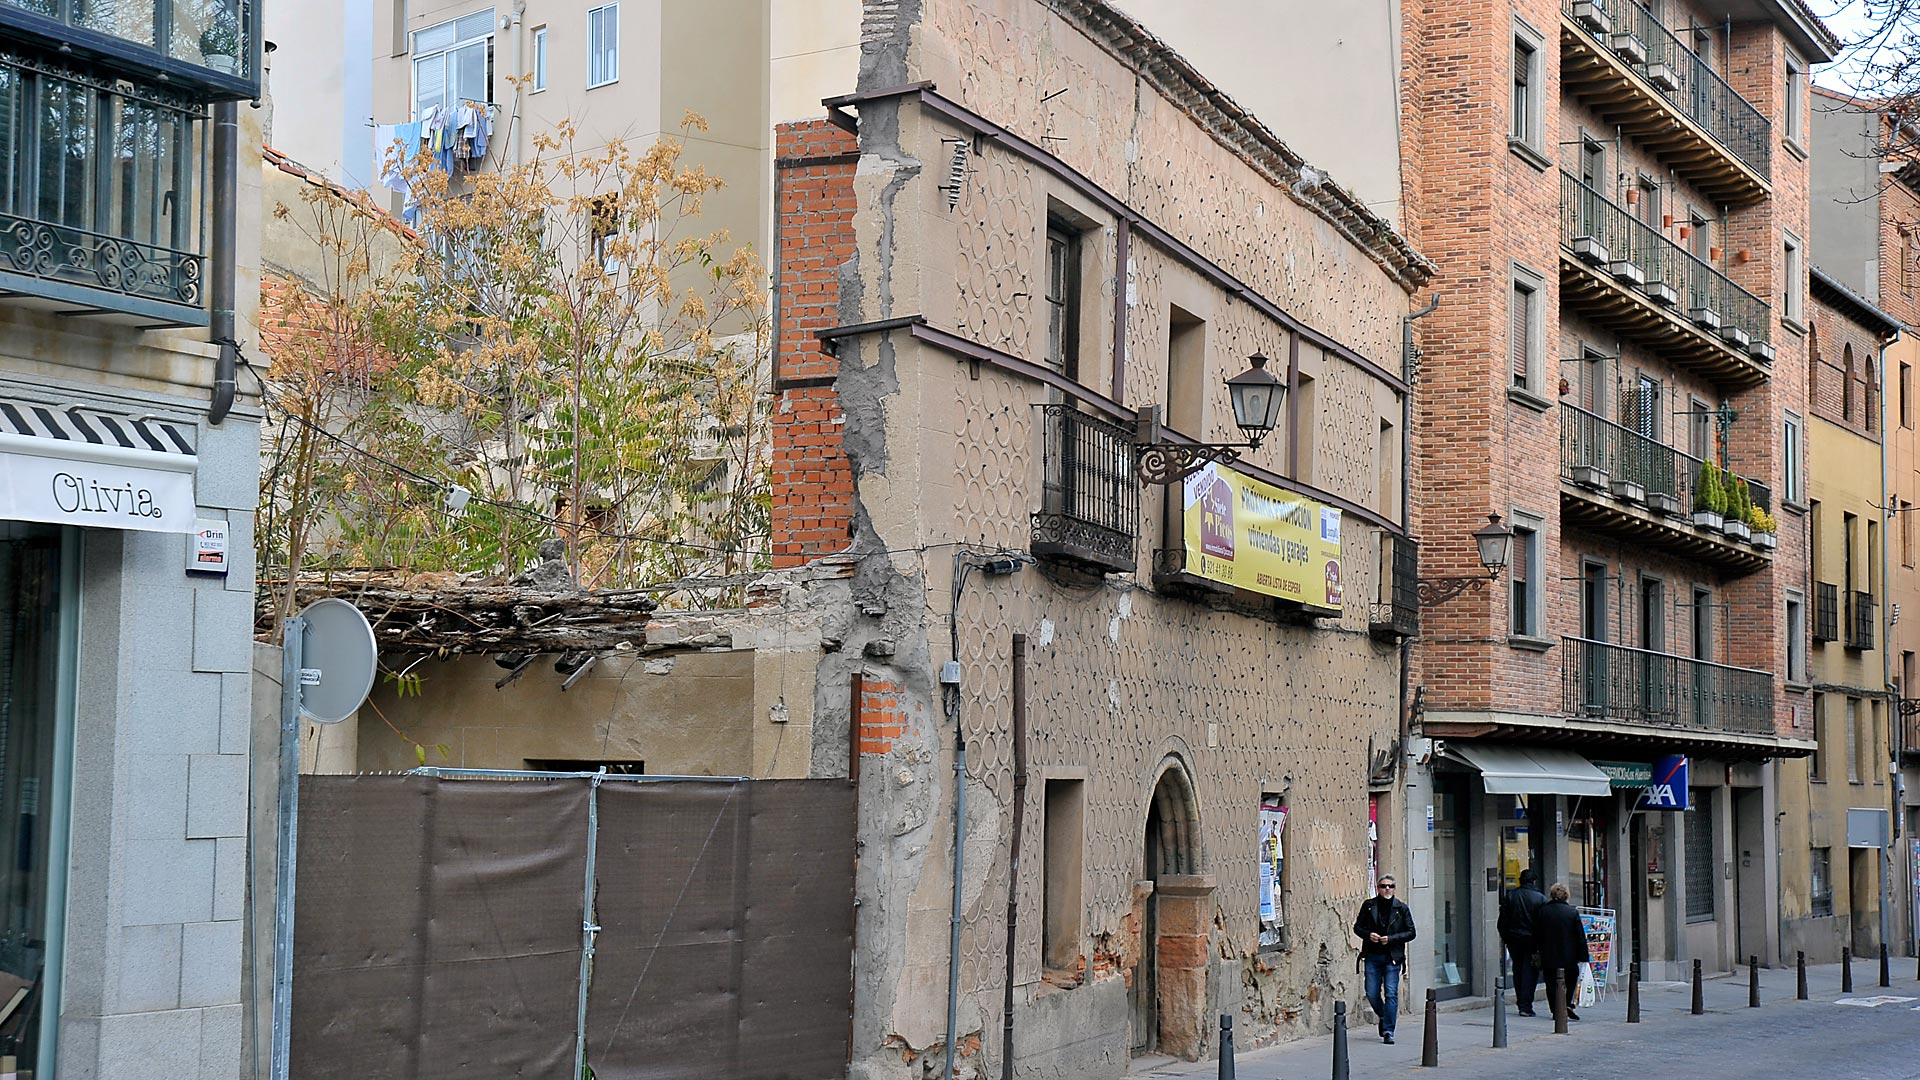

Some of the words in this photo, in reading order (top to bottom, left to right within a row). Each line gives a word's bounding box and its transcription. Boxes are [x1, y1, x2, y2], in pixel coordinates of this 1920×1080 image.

[53, 472, 163, 519] Olivia
[1193, 469, 1214, 500] VENDIDO
[206, 530, 223, 539] Drin
[1215, 514, 1233, 539] Picos
[1248, 524, 1280, 555] viviendas
[1280, 538, 1286, 562] y
[1287, 539, 1308, 567] garajes
[1642, 783, 1677, 805] AXA
